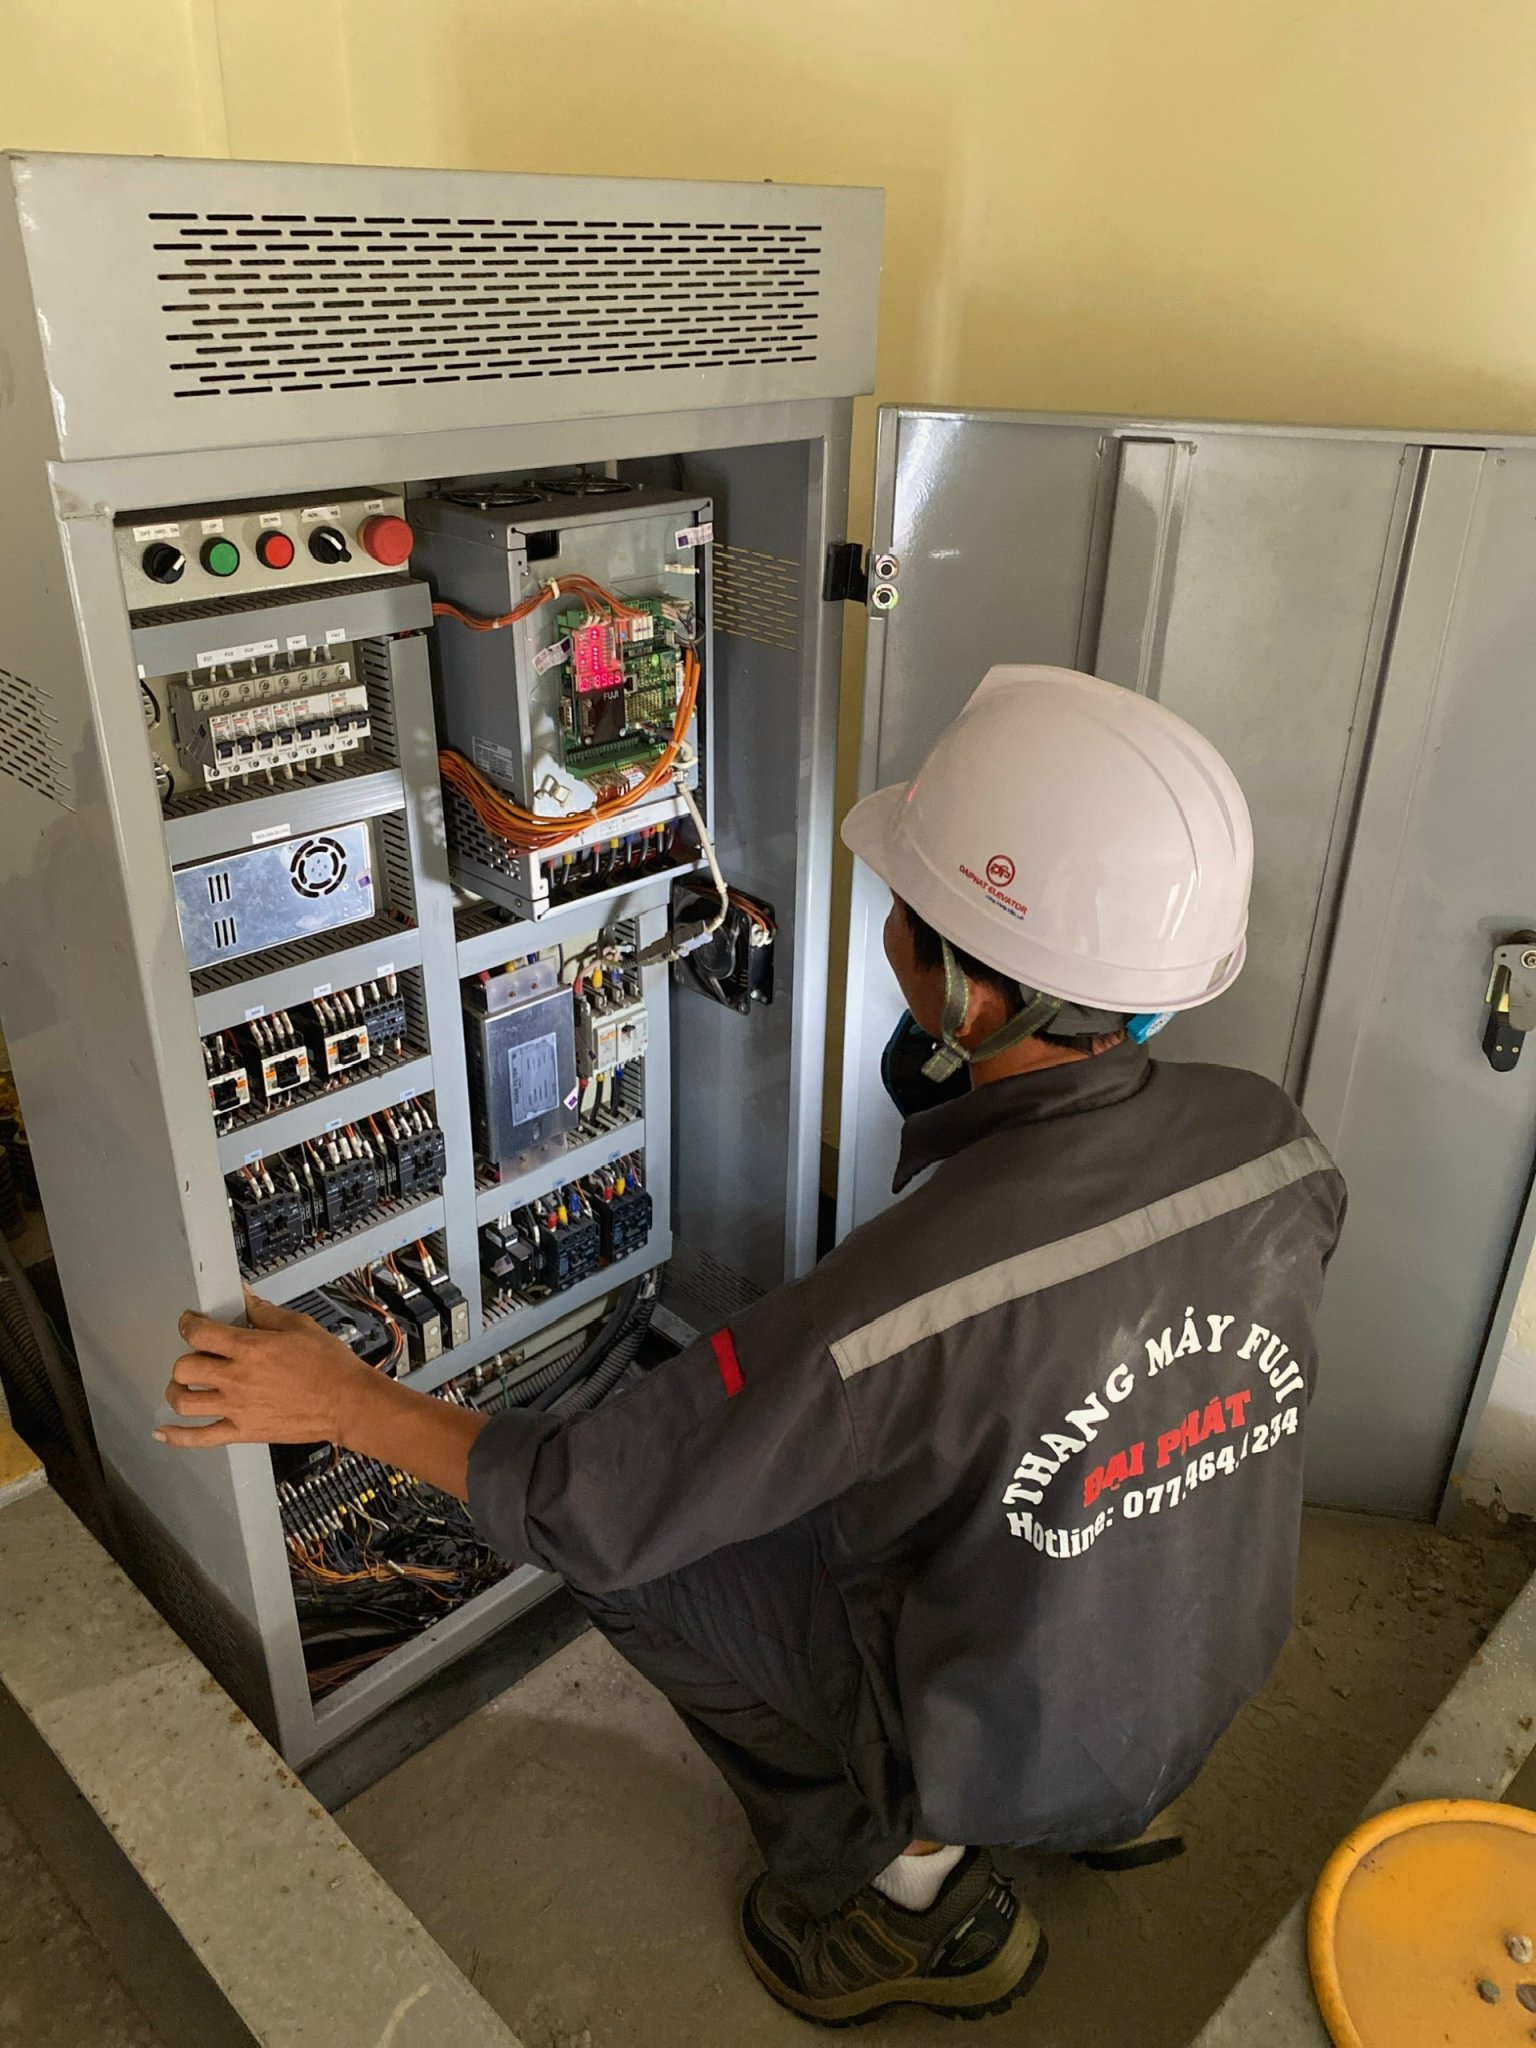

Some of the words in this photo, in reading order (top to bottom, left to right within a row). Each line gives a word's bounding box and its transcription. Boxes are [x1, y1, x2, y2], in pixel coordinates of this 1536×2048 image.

[603, 690, 620, 701] FUJI
[987, 886, 1028, 915] ELEVATOR
[1001, 1362, 1136, 1507] THANG
[1144, 1305, 1236, 1377] MÁY
[1236, 1322, 1305, 1405] FUJI
[1156, 1389, 1253, 1470] PHÁT
[1005, 1506, 1115, 1560] Hotline:
